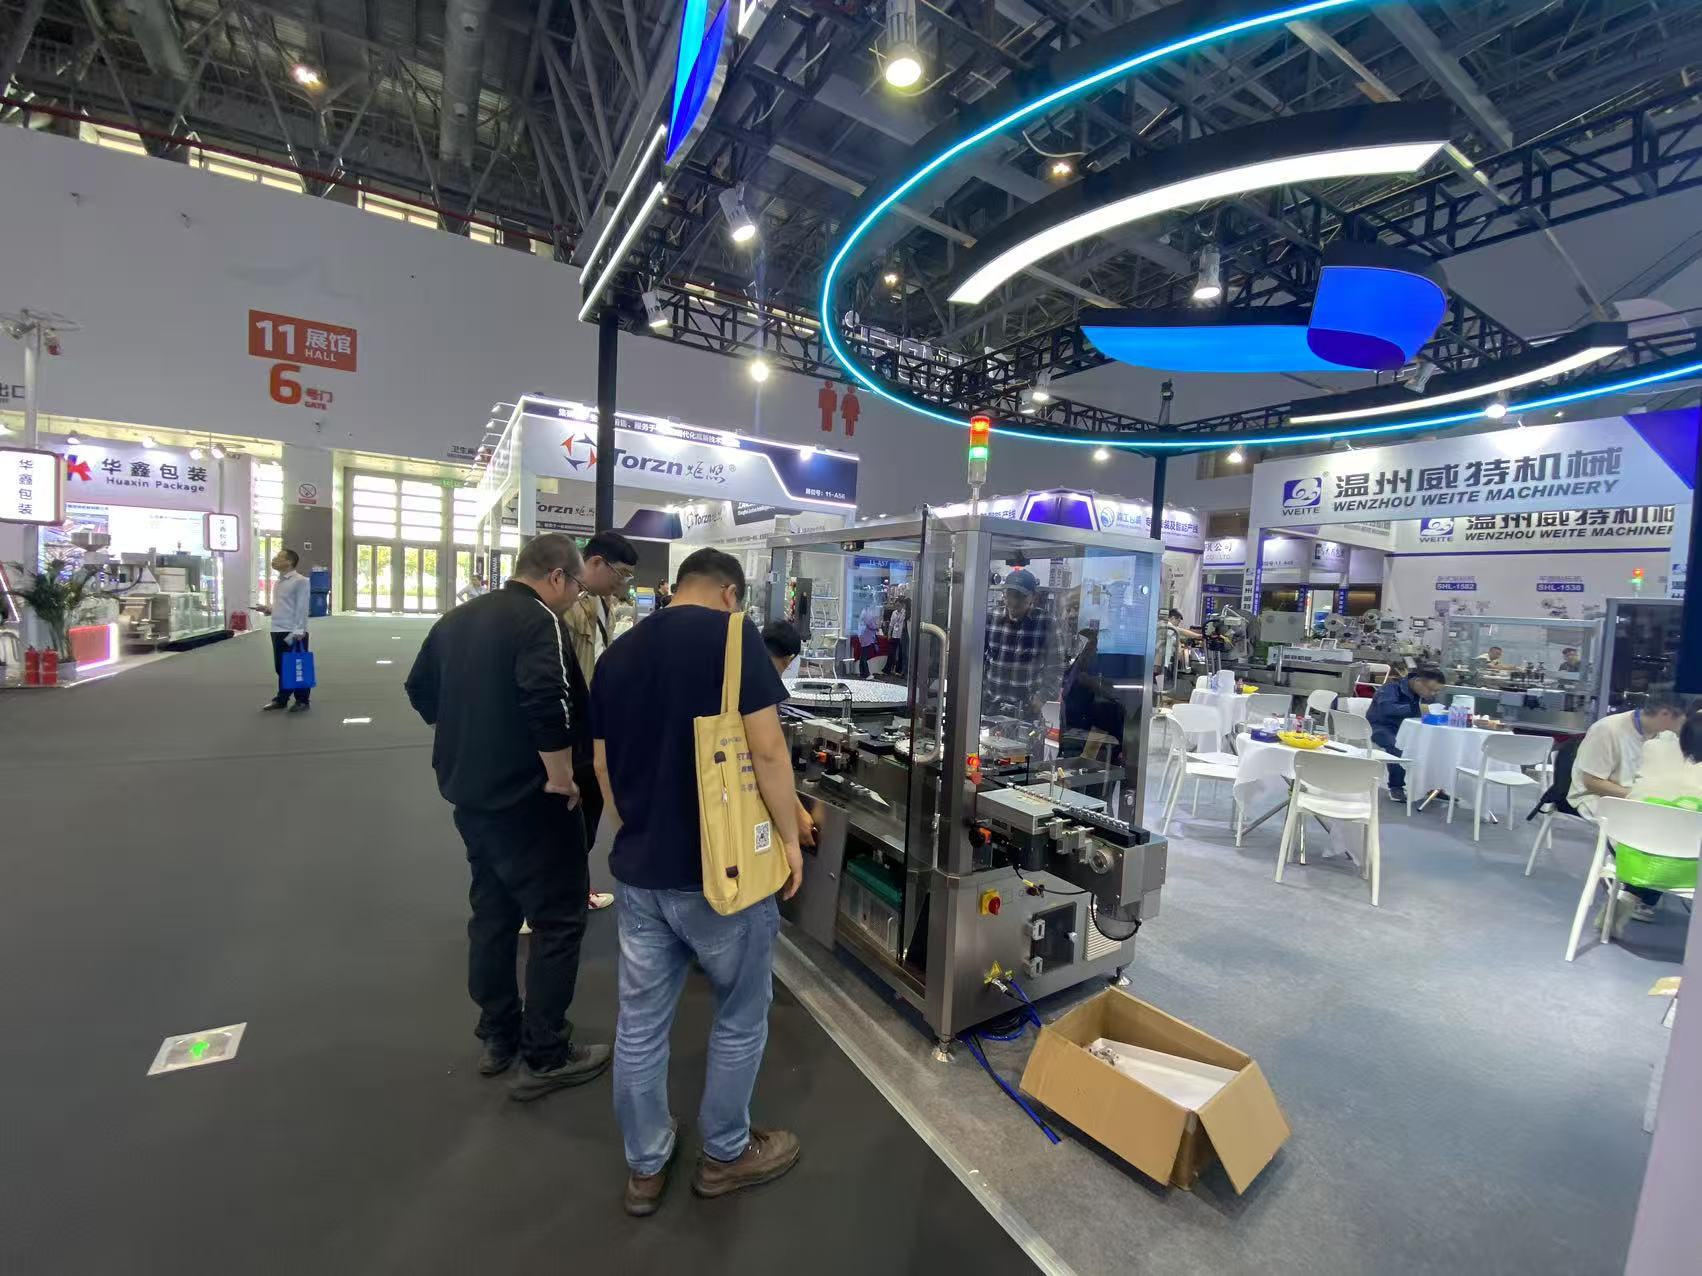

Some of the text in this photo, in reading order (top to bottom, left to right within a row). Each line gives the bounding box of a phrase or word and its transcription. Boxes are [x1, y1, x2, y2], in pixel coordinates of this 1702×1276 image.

[256, 320, 351, 355] 11 展馆
[305, 349, 337, 362] HALL
[270, 363, 302, 405] 6
[101, 458, 208, 483] 华鑫包装
[106, 476, 206, 493] Huaxin Package
[1334, 447, 1623, 498] 温州威特机械
[18, 458, 34, 515] 华鑫包装
[1333, 479, 1619, 512] WENZHOU WEITE MACHINERY
[1282, 507, 1320, 516] WEITE
[1465, 530, 1535, 541] WENZHOU
[1540, 528, 1586, 538] WEITE
